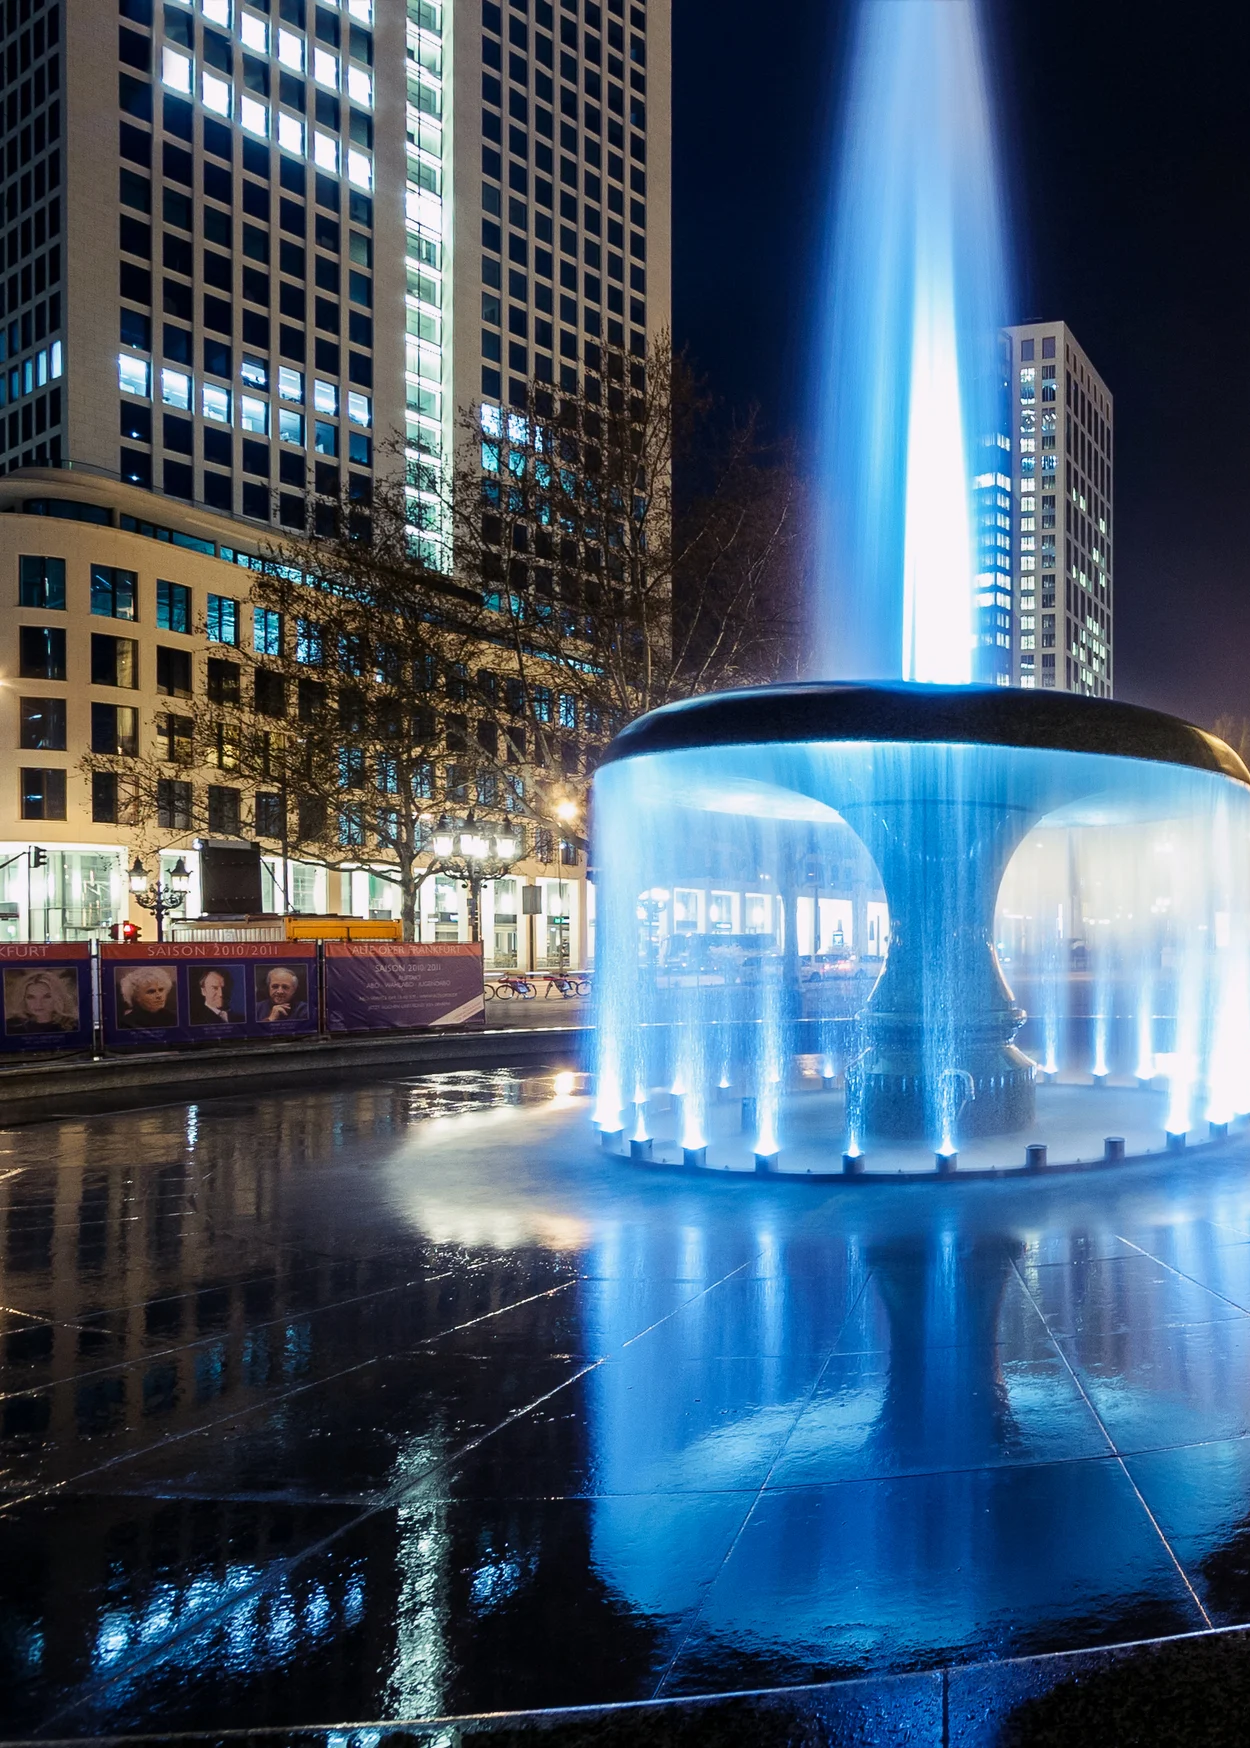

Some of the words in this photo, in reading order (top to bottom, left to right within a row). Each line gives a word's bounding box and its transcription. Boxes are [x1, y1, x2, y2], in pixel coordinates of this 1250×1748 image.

[147, 945, 206, 957] SAISON
[213, 945, 278, 956] 2010/2011
[352, 945, 376, 955] ALTE
[378, 945, 405, 955] OPER
[408, 945, 461, 955] FRANKFURT
[375, 963, 406, 973] SAISON
